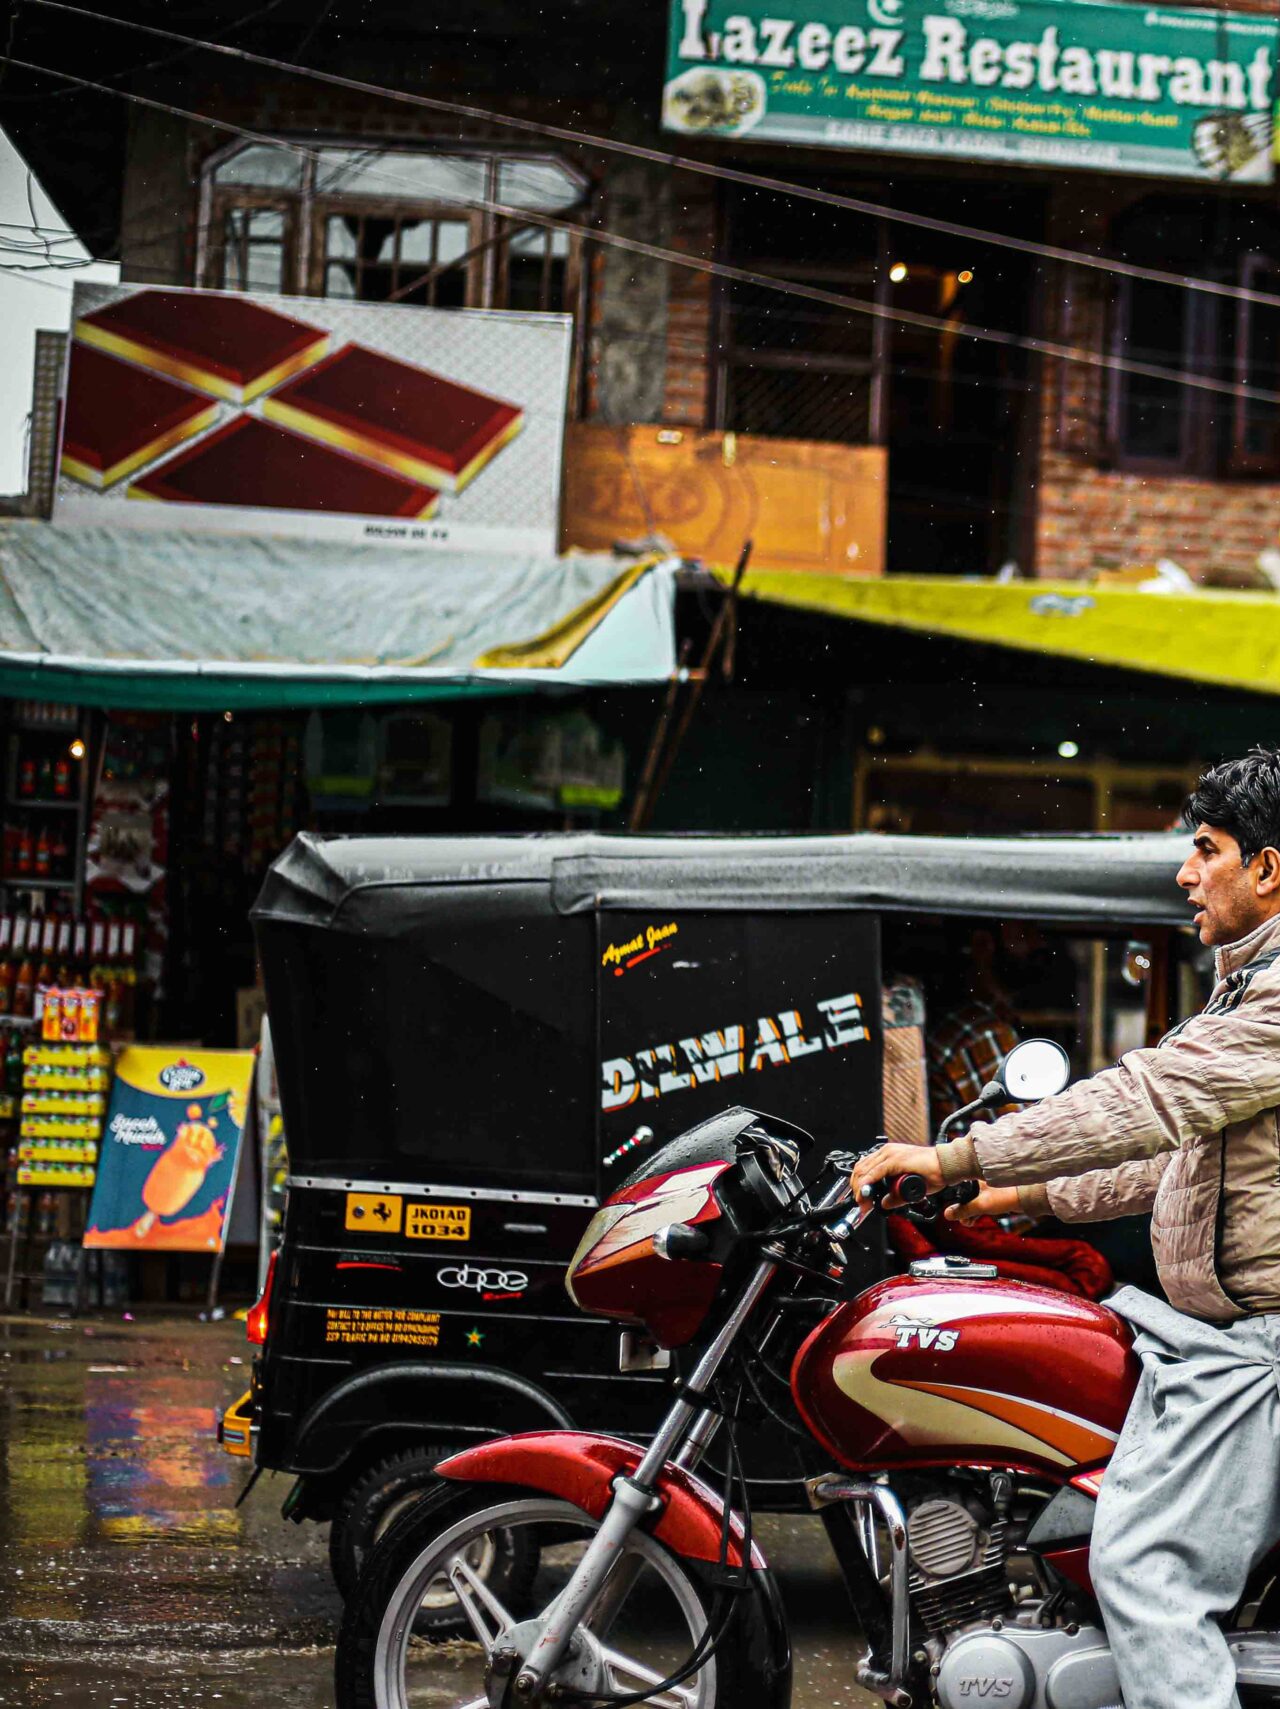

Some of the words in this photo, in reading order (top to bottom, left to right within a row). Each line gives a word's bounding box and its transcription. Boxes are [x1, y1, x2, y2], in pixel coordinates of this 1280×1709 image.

[678, 0, 904, 77] Lazeez
[919, 14, 1273, 109] Restaurant
[601, 993, 870, 1112] DILWALE
[411, 1223, 467, 1237] 1034
[894, 1326, 960, 1352] TVS
[959, 1676, 1013, 1698] TVS
